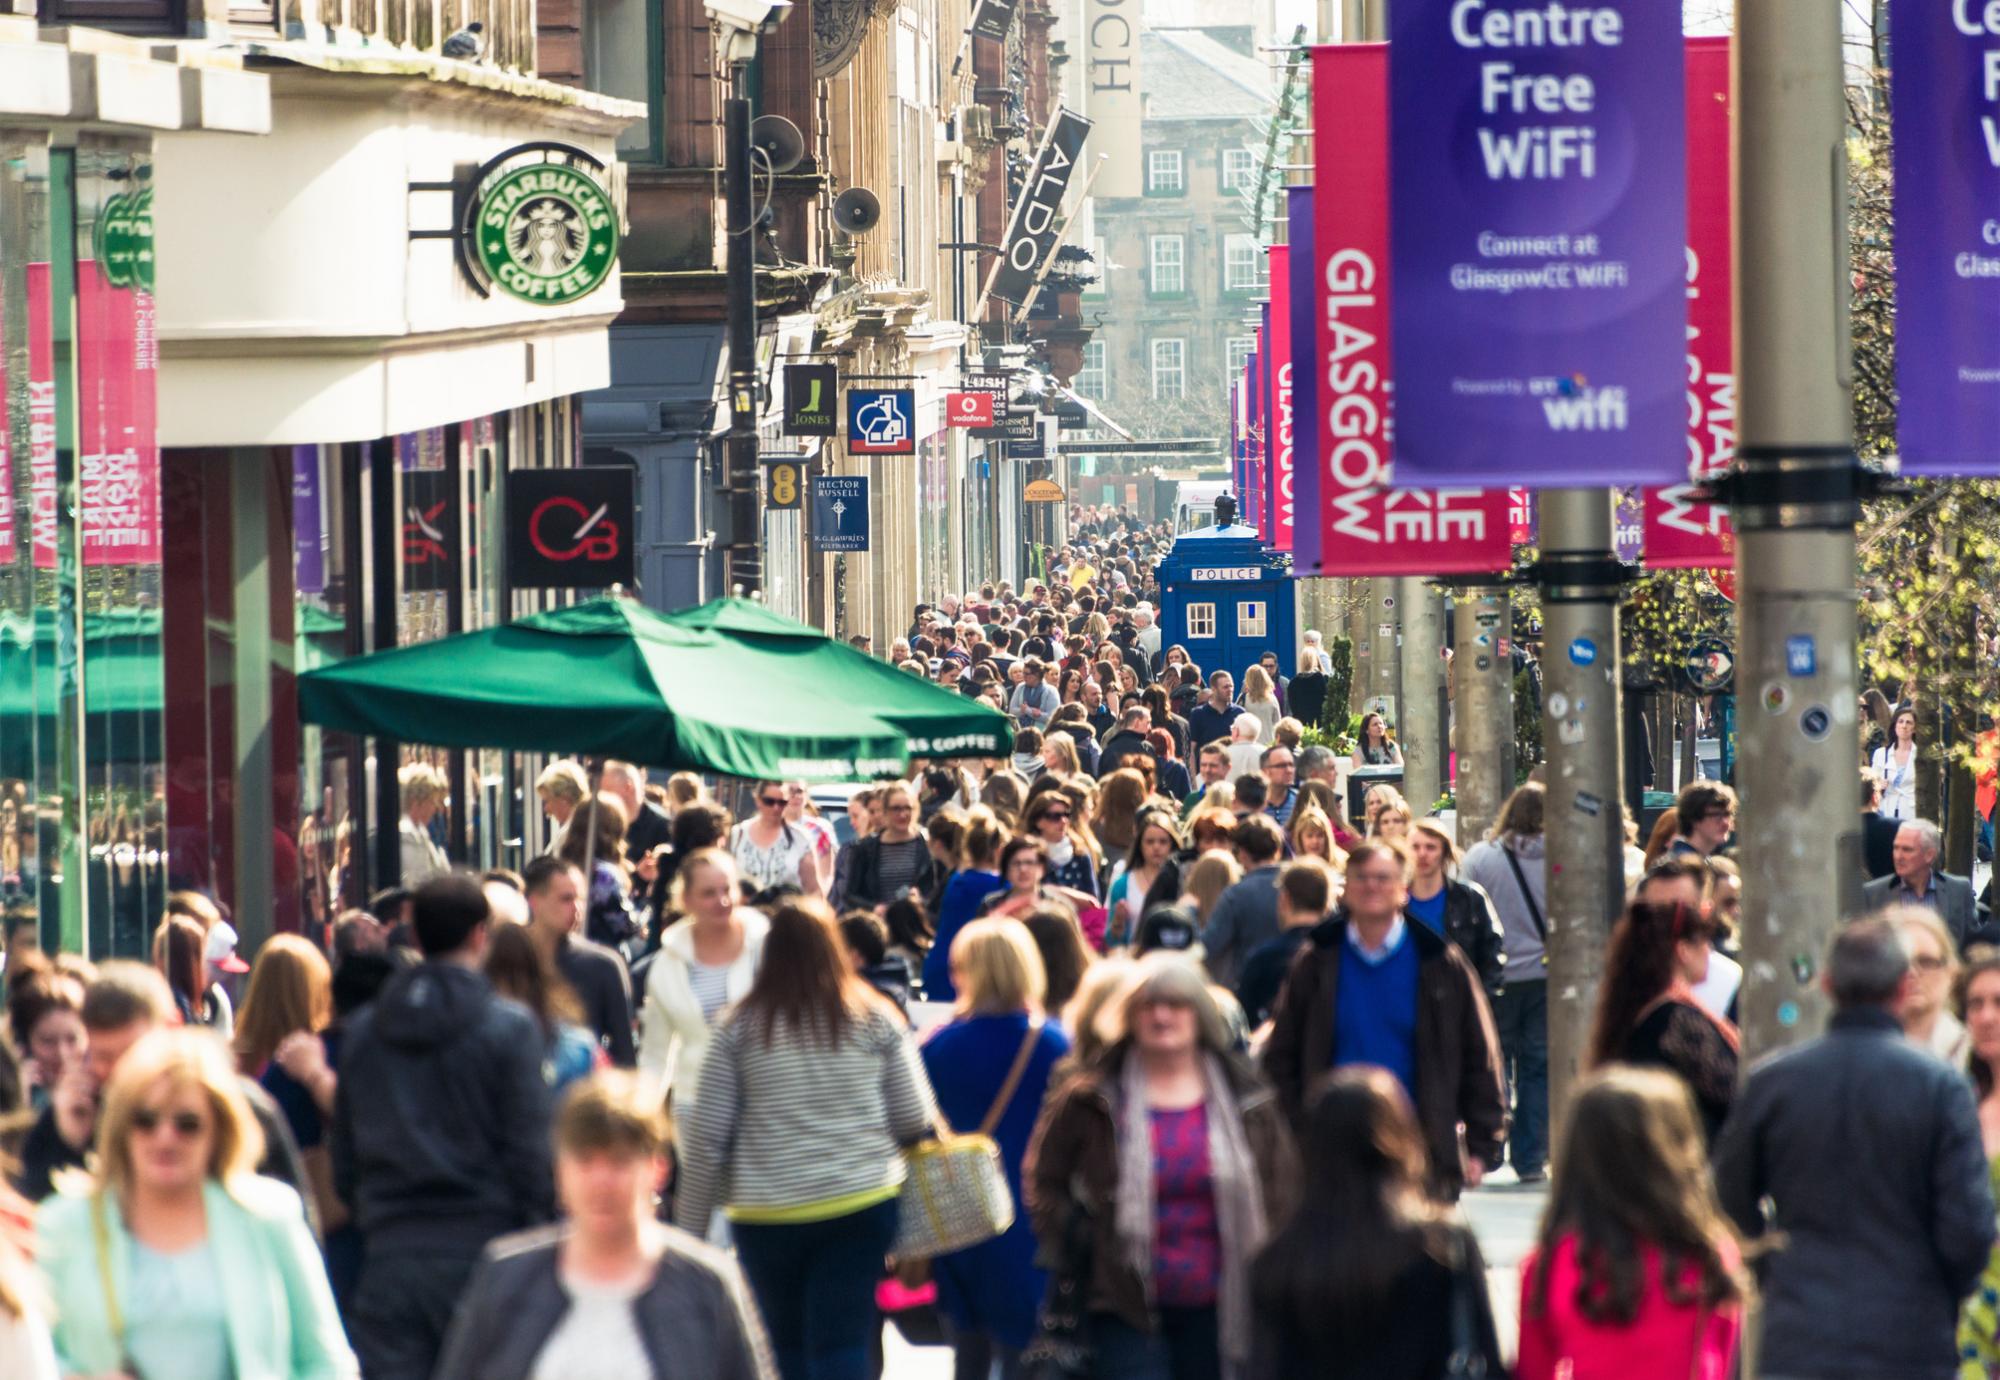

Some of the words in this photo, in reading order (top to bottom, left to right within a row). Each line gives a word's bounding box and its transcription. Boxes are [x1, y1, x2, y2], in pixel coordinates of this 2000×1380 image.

[1451, 0, 1622, 47] Centre
[1482, 62, 1595, 113] Free
[1478, 128, 1595, 180] WiFi
[485, 171, 610, 230] STARBUCKS
[1011, 142, 1070, 271] ALDO
[1478, 231, 1569, 257] Connect
[1574, 233, 1597, 255] at
[498, 262, 593, 299] COFFEE
[1451, 263, 1571, 293] GlasgowCC
[964, 376, 1006, 389] LUSH
[1326, 248, 1381, 543] GLASGOW
[790, 414, 831, 426] JONES
[1543, 387, 1627, 431] wifi
[818, 479, 859, 489] HECTOR
[818, 489, 859, 497] RUSSELL
[1196, 568, 1255, 580] POLICE
[932, 734, 997, 752] COFFEE
